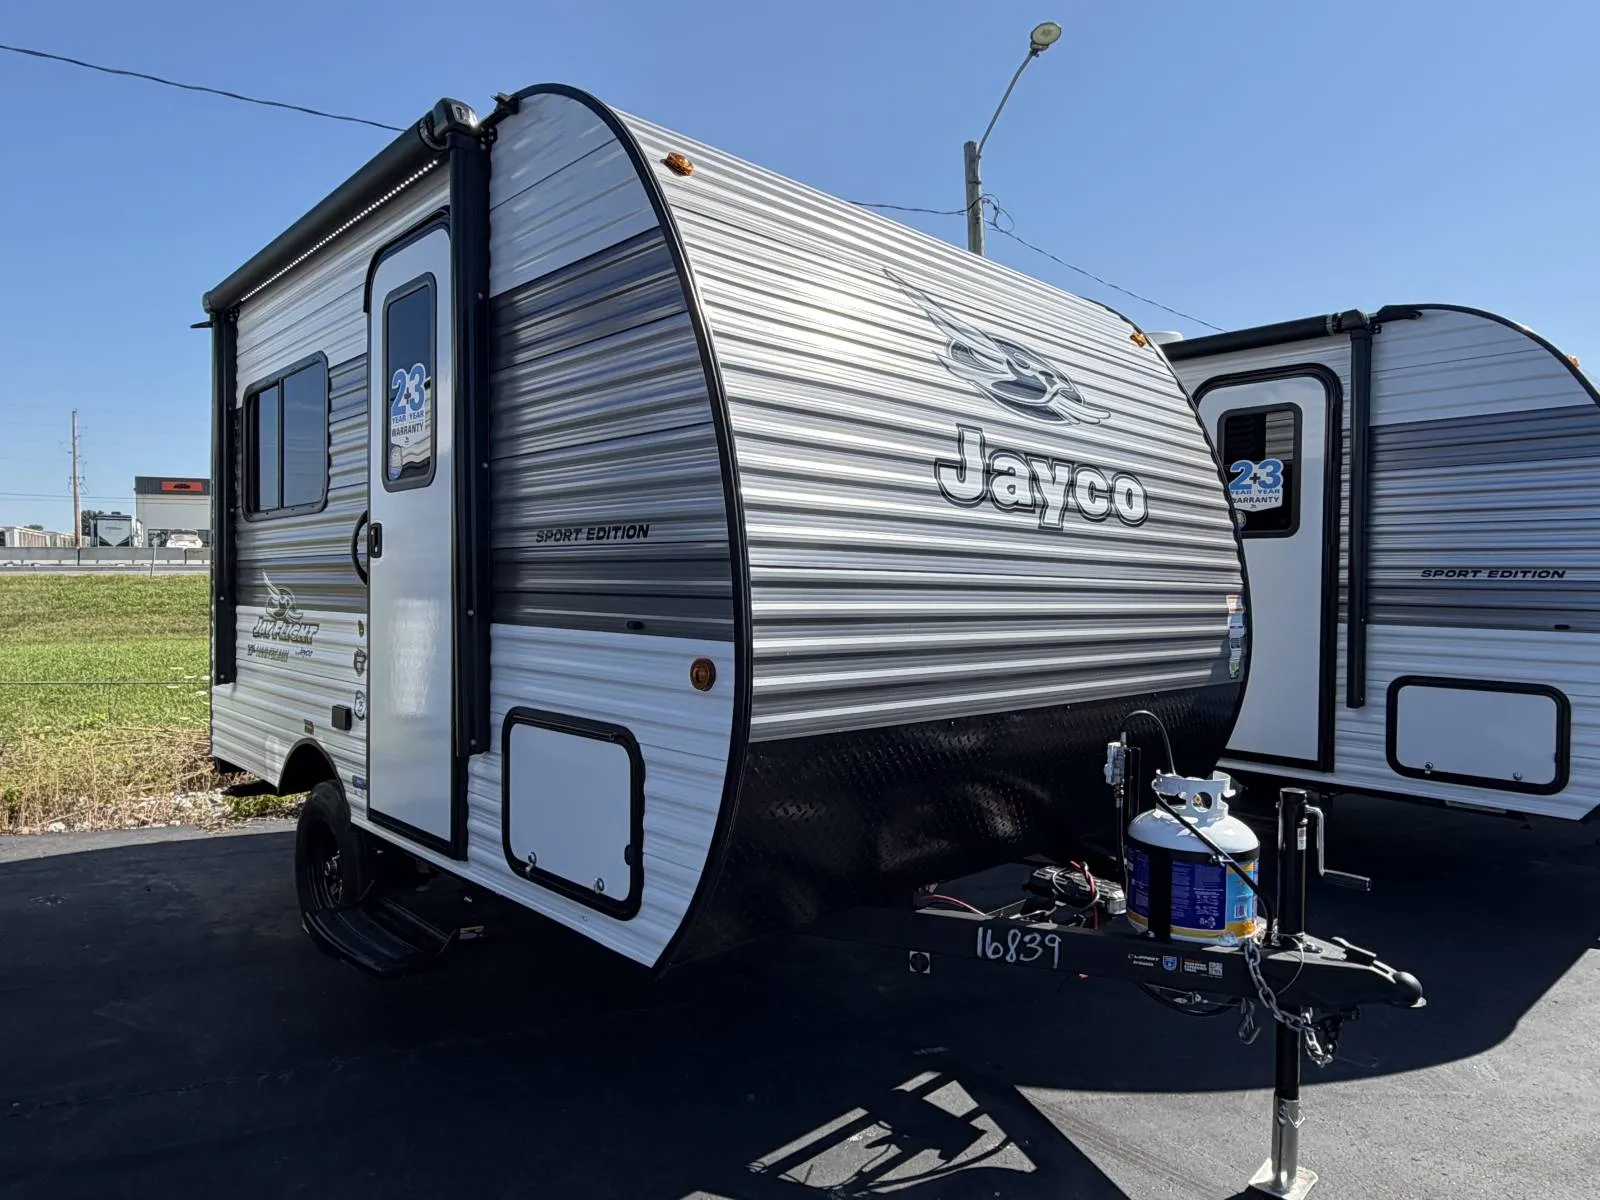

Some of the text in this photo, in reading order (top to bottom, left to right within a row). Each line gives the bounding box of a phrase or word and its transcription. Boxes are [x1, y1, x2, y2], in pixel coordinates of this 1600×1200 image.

[409, 410, 424, 420] YEAR
[391, 422, 424, 437] WARRANTY
[934, 423, 1149, 532] Jayco
[535, 524, 650, 543] SPORT EDITION
[1420, 569, 1567, 579] SPORT EDITION
[976, 926, 1062, 969] 16839
